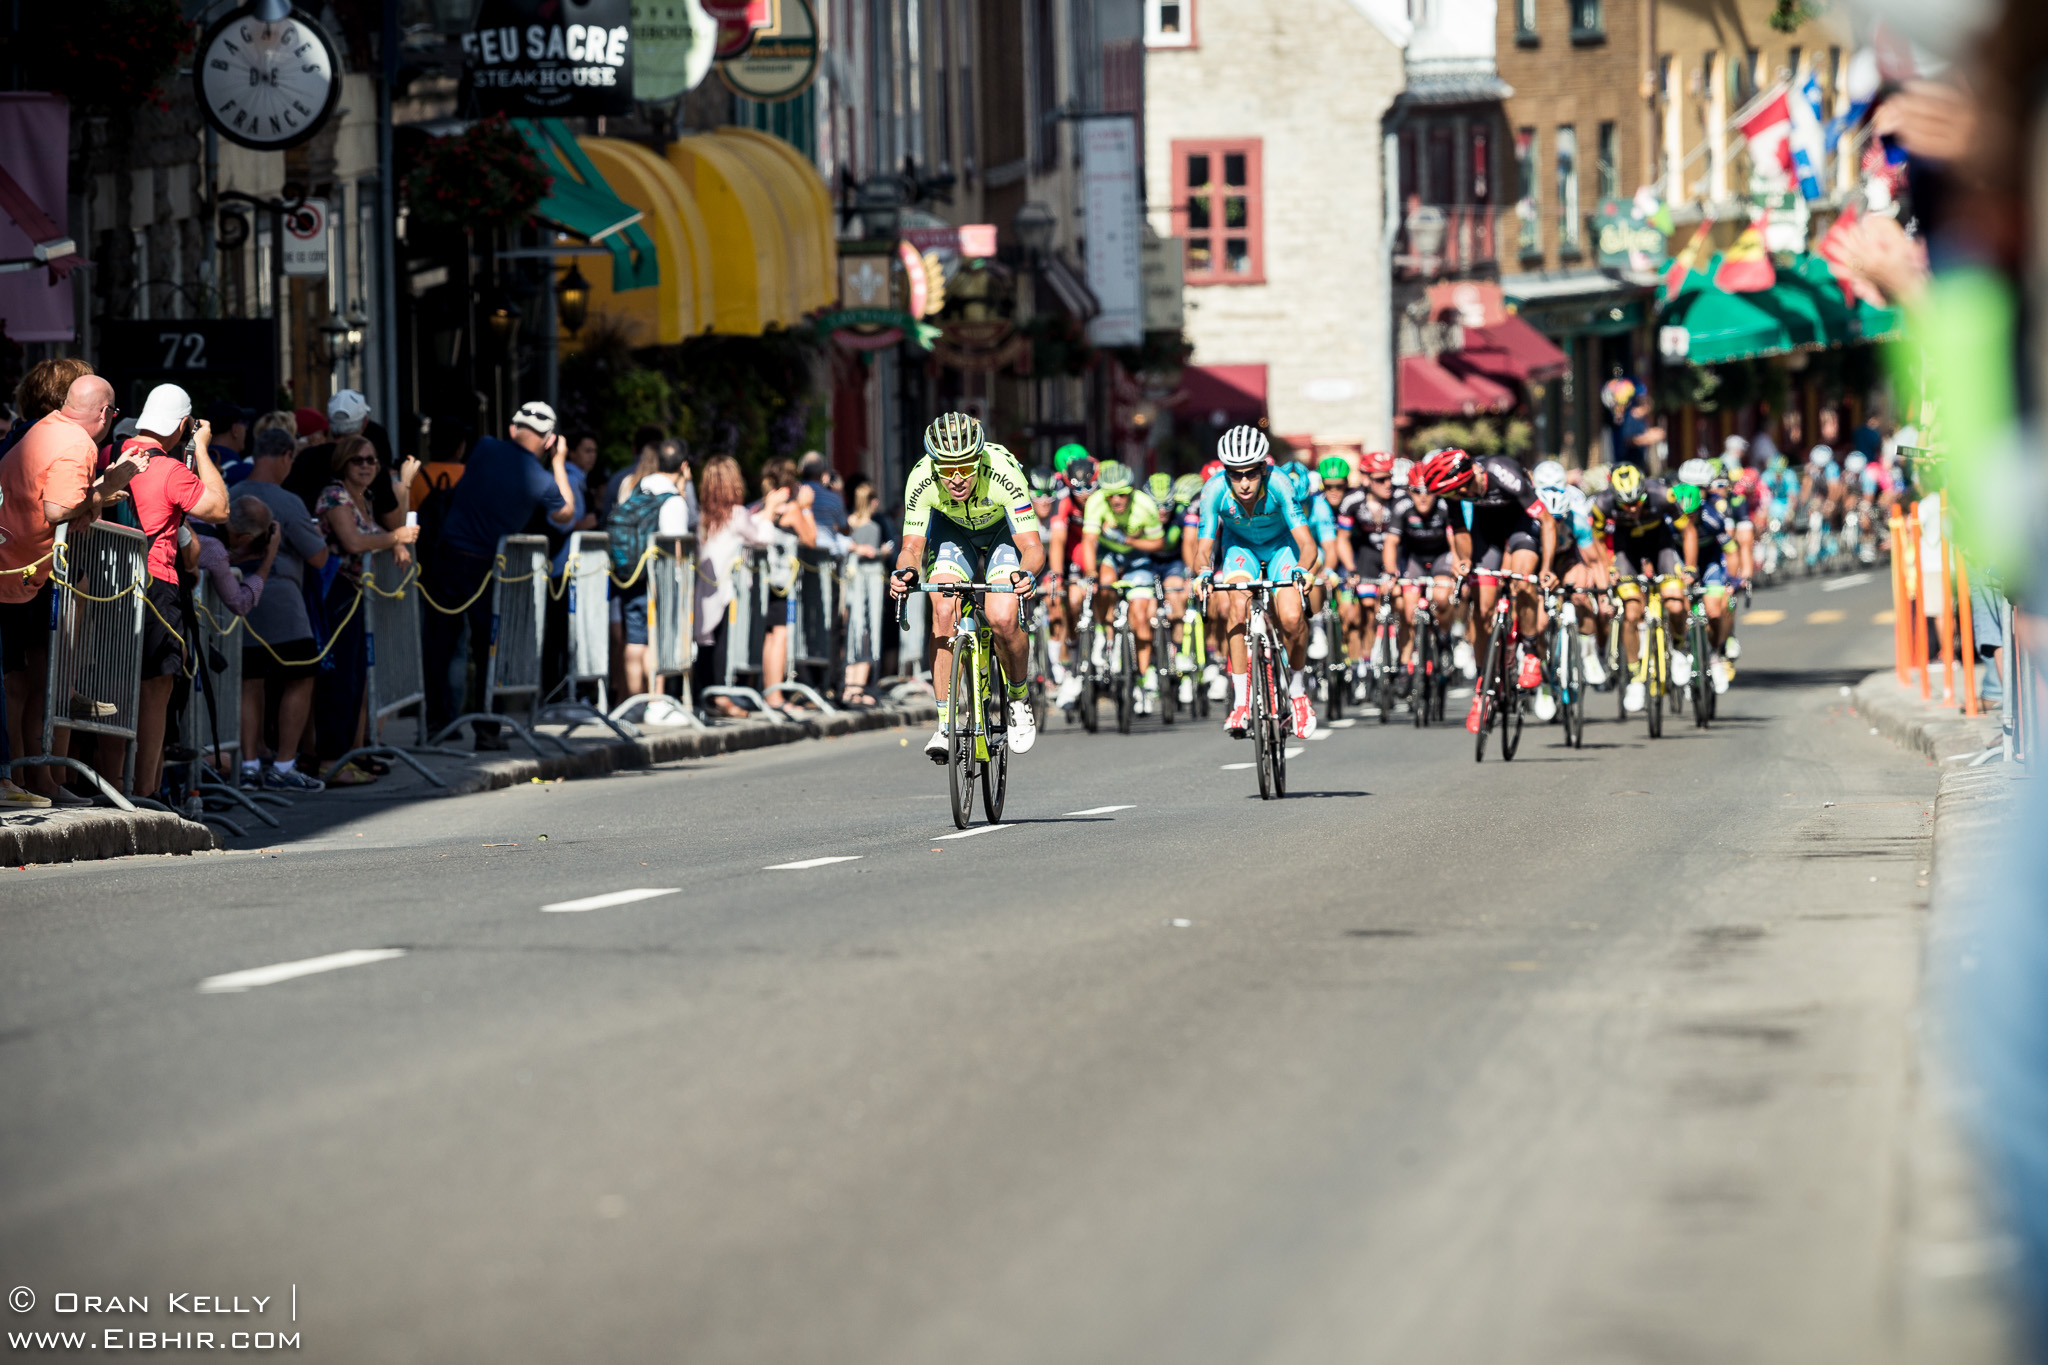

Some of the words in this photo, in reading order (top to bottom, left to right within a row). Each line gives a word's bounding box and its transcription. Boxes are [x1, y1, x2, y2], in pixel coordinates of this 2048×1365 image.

[461, 26, 520, 65] FEU
[525, 24, 629, 67] SACRÉ
[249, 67, 279, 87] DE
[473, 67, 617, 88] STEAKHOUSE
[219, 99, 312, 135] FRANCE
[159, 332, 208, 368] 72
[982, 464, 1025, 500] Tinkoff
